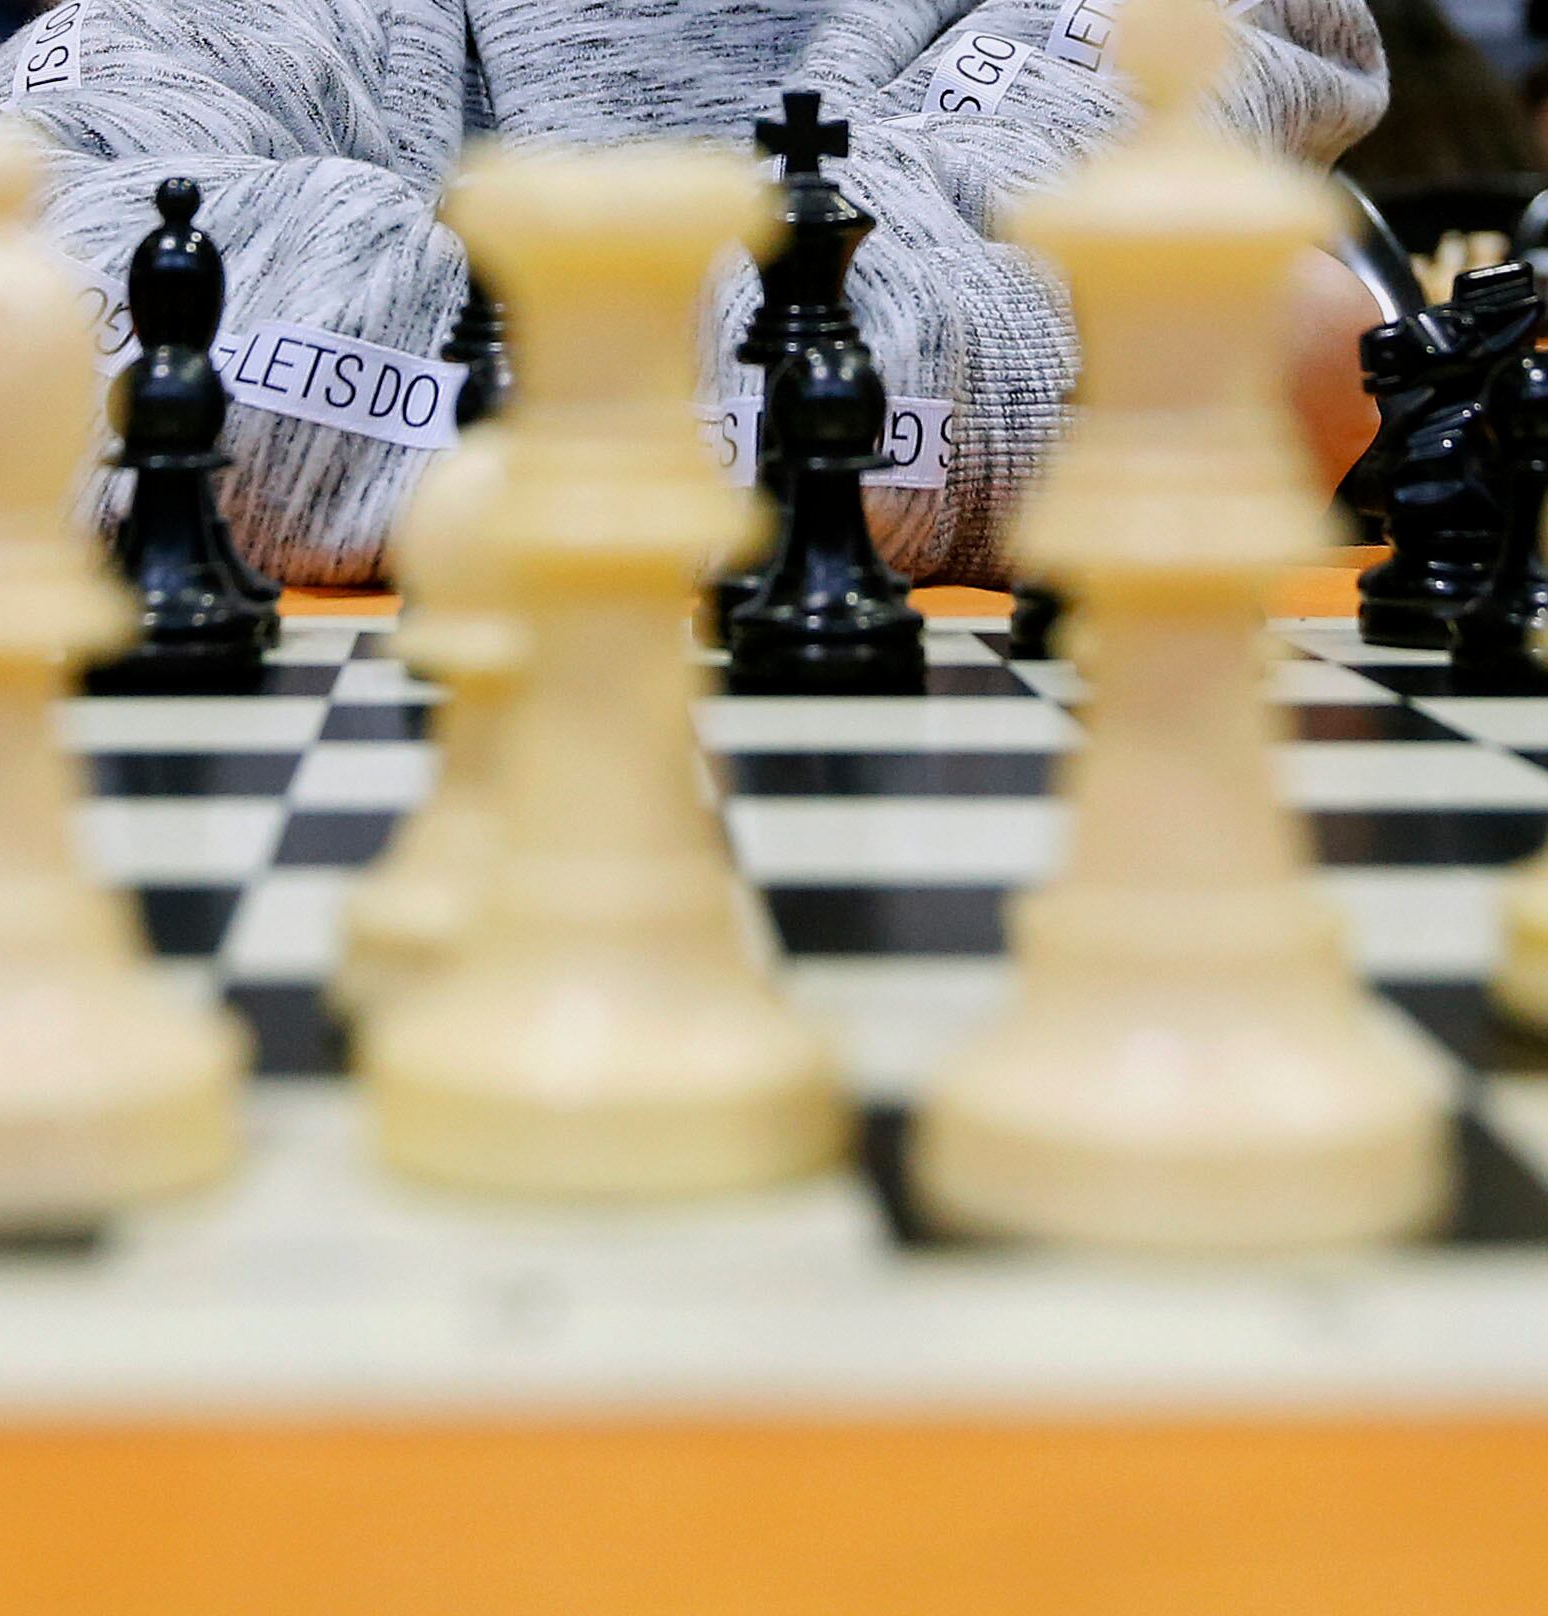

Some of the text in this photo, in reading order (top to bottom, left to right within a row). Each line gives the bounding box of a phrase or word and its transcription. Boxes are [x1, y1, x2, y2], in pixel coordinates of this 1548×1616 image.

[955, 34, 1016, 86] GO
[235, 333, 364, 409] LETS
[368, 363, 440, 429] DO
